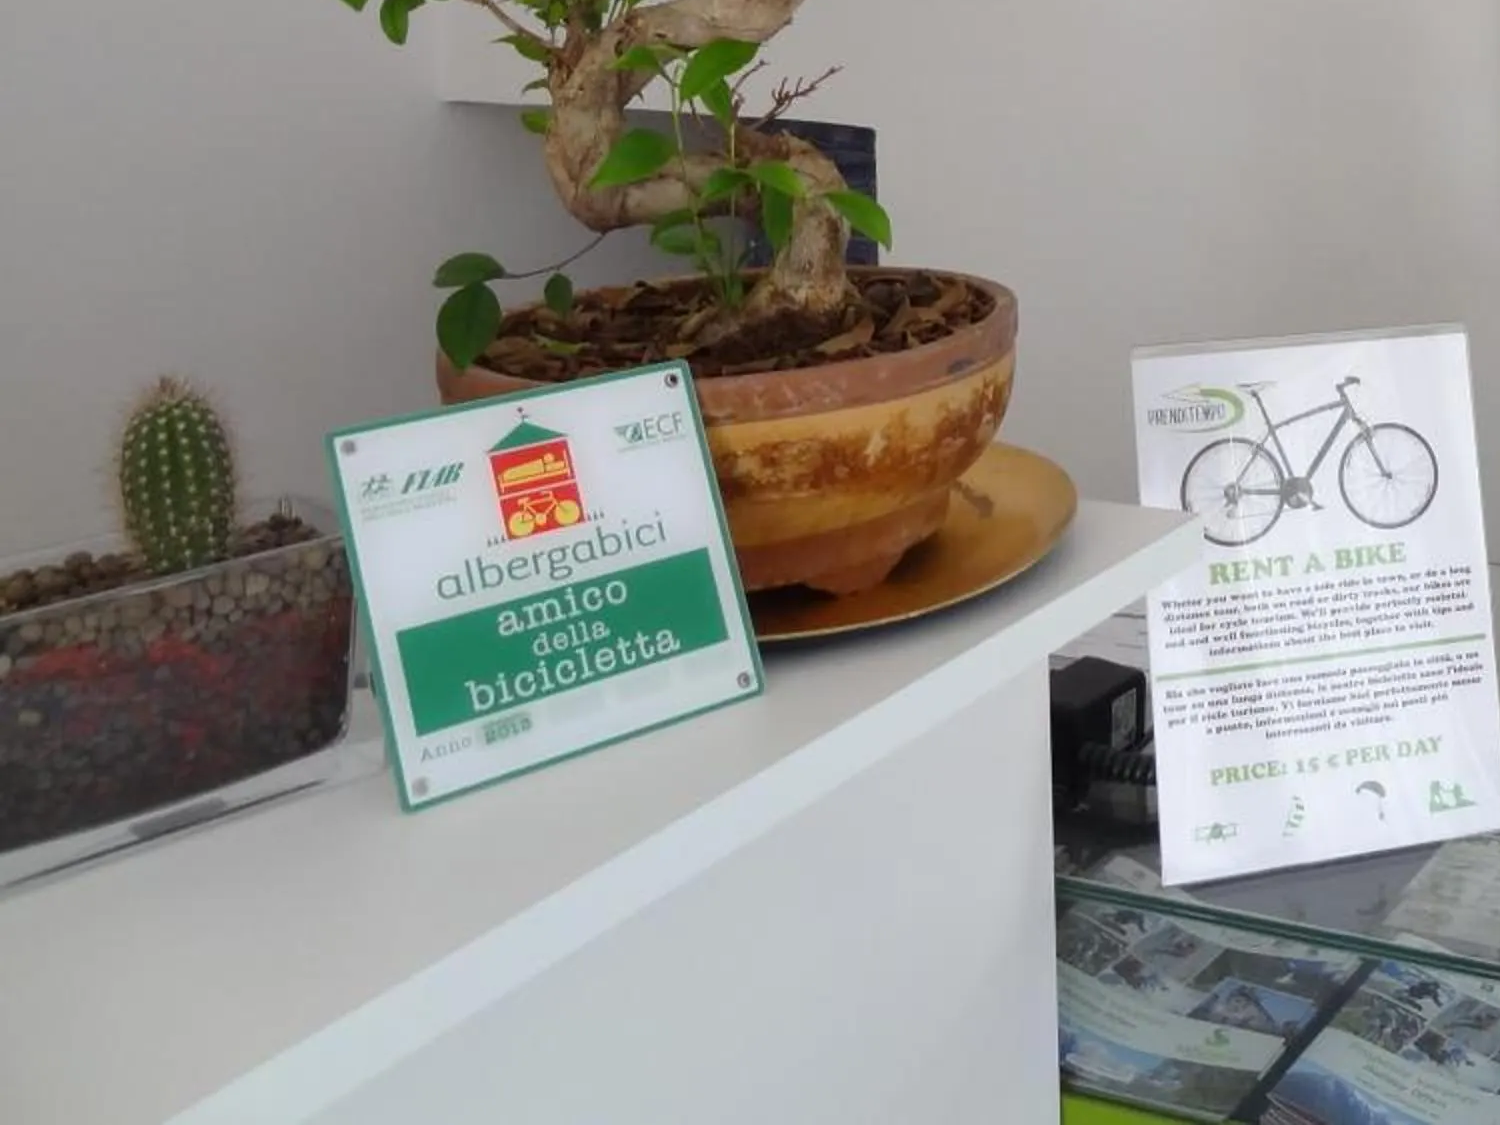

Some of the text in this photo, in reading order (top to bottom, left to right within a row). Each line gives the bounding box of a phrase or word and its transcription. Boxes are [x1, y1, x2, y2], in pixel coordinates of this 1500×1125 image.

[436, 511, 668, 601] albergabici
[1208, 541, 1408, 587] RENT A BIKE
[496, 579, 628, 638] amico
[532, 620, 612, 657] della
[464, 627, 681, 713] bicicletta
[420, 736, 473, 763] Anno
[1209, 759, 1289, 787] PRICE:
[1344, 741, 1393, 767] PER
[1396, 736, 1443, 759] DAY
